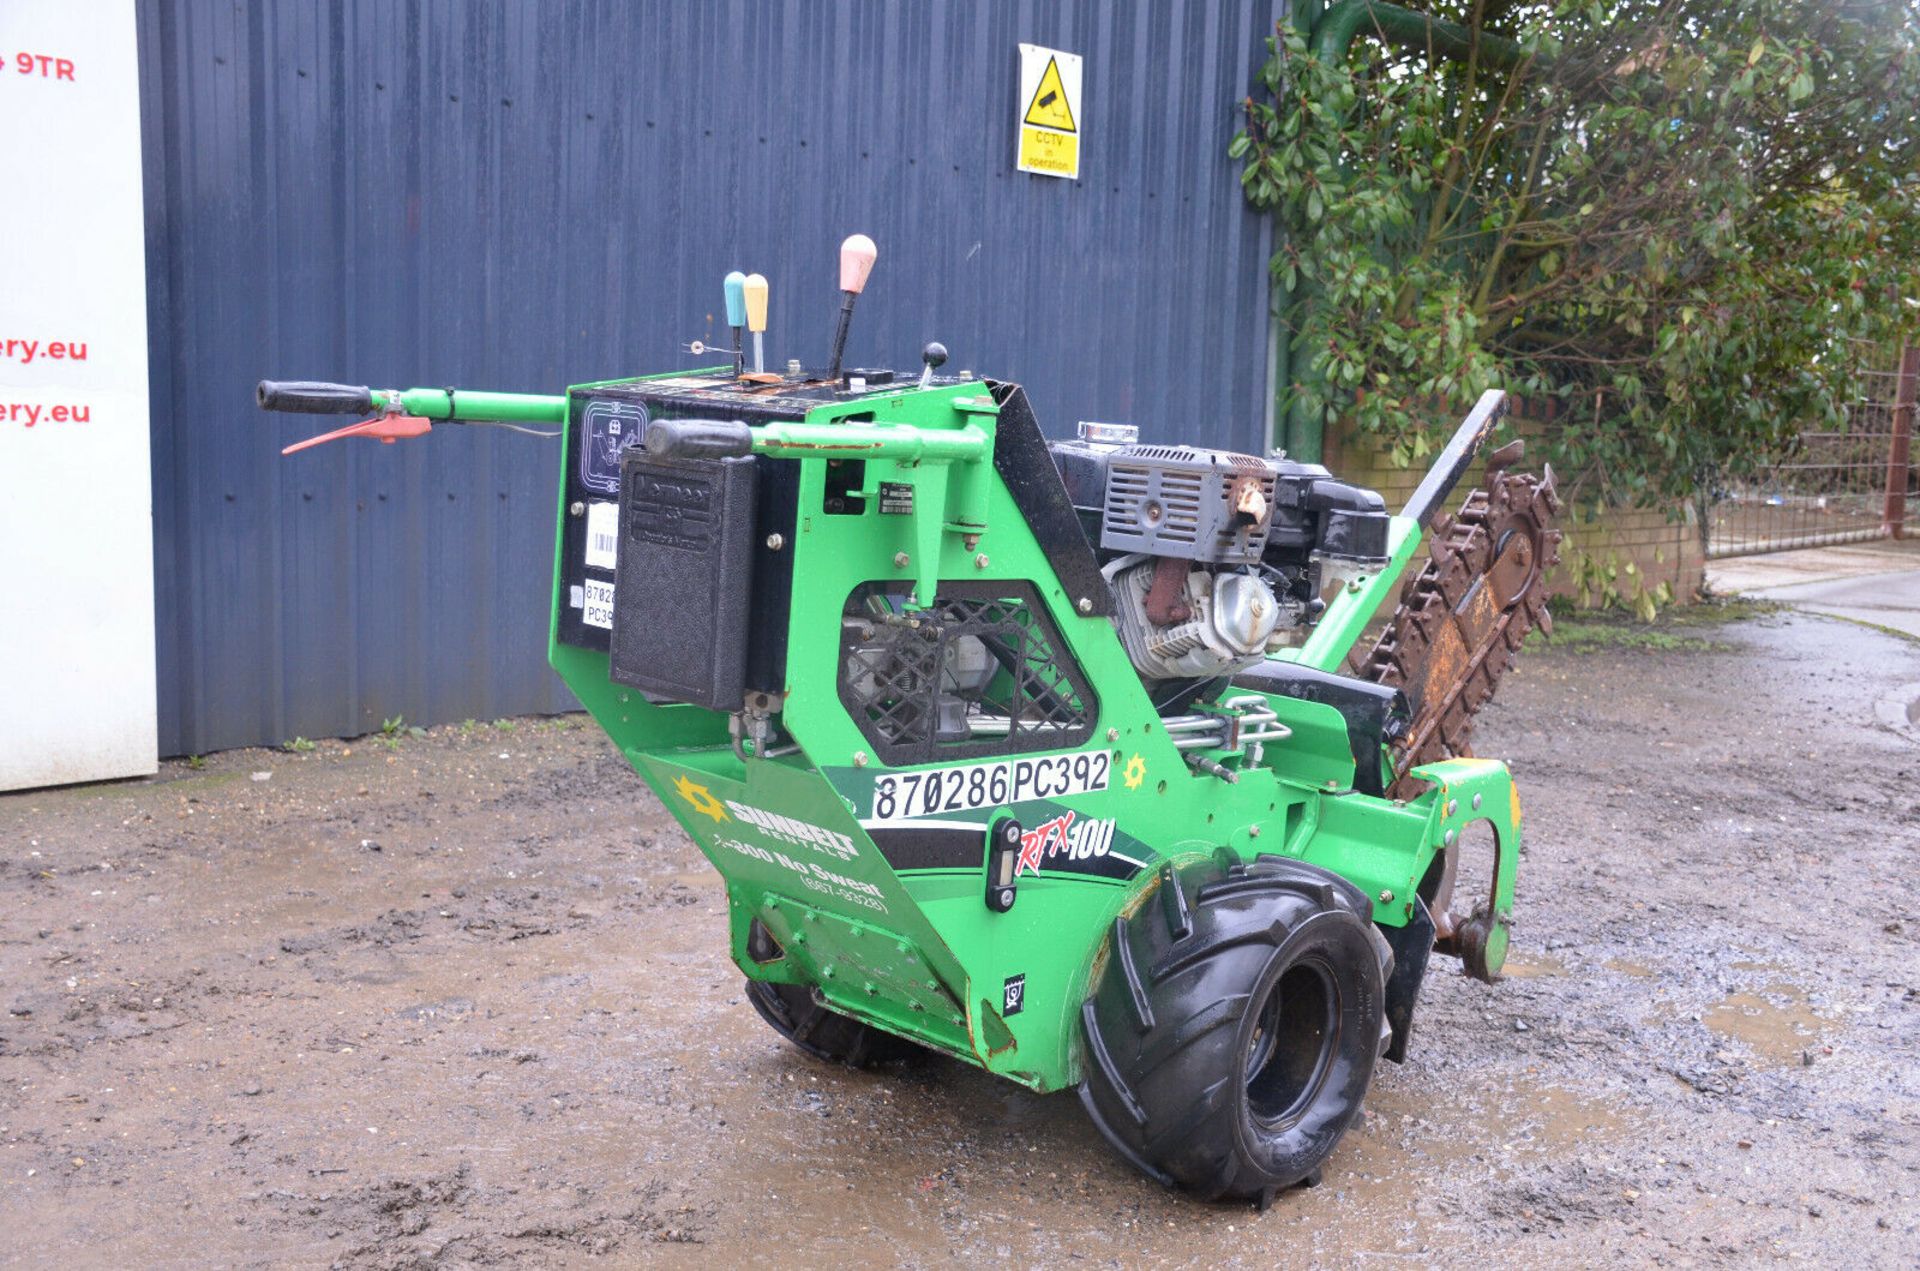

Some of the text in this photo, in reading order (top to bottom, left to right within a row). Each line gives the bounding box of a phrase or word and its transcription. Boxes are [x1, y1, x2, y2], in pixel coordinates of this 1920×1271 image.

[16, 52, 75, 82] 9TR
[1036, 131, 1064, 147] CCTV
[1028, 157, 1069, 170] operation
[0, 339, 87, 364] ry.eu
[725, 799, 860, 857] SUNBELT
[758, 826, 852, 862] RENTALS
[773, 851, 810, 874] No
[809, 862, 885, 899] Sweat
